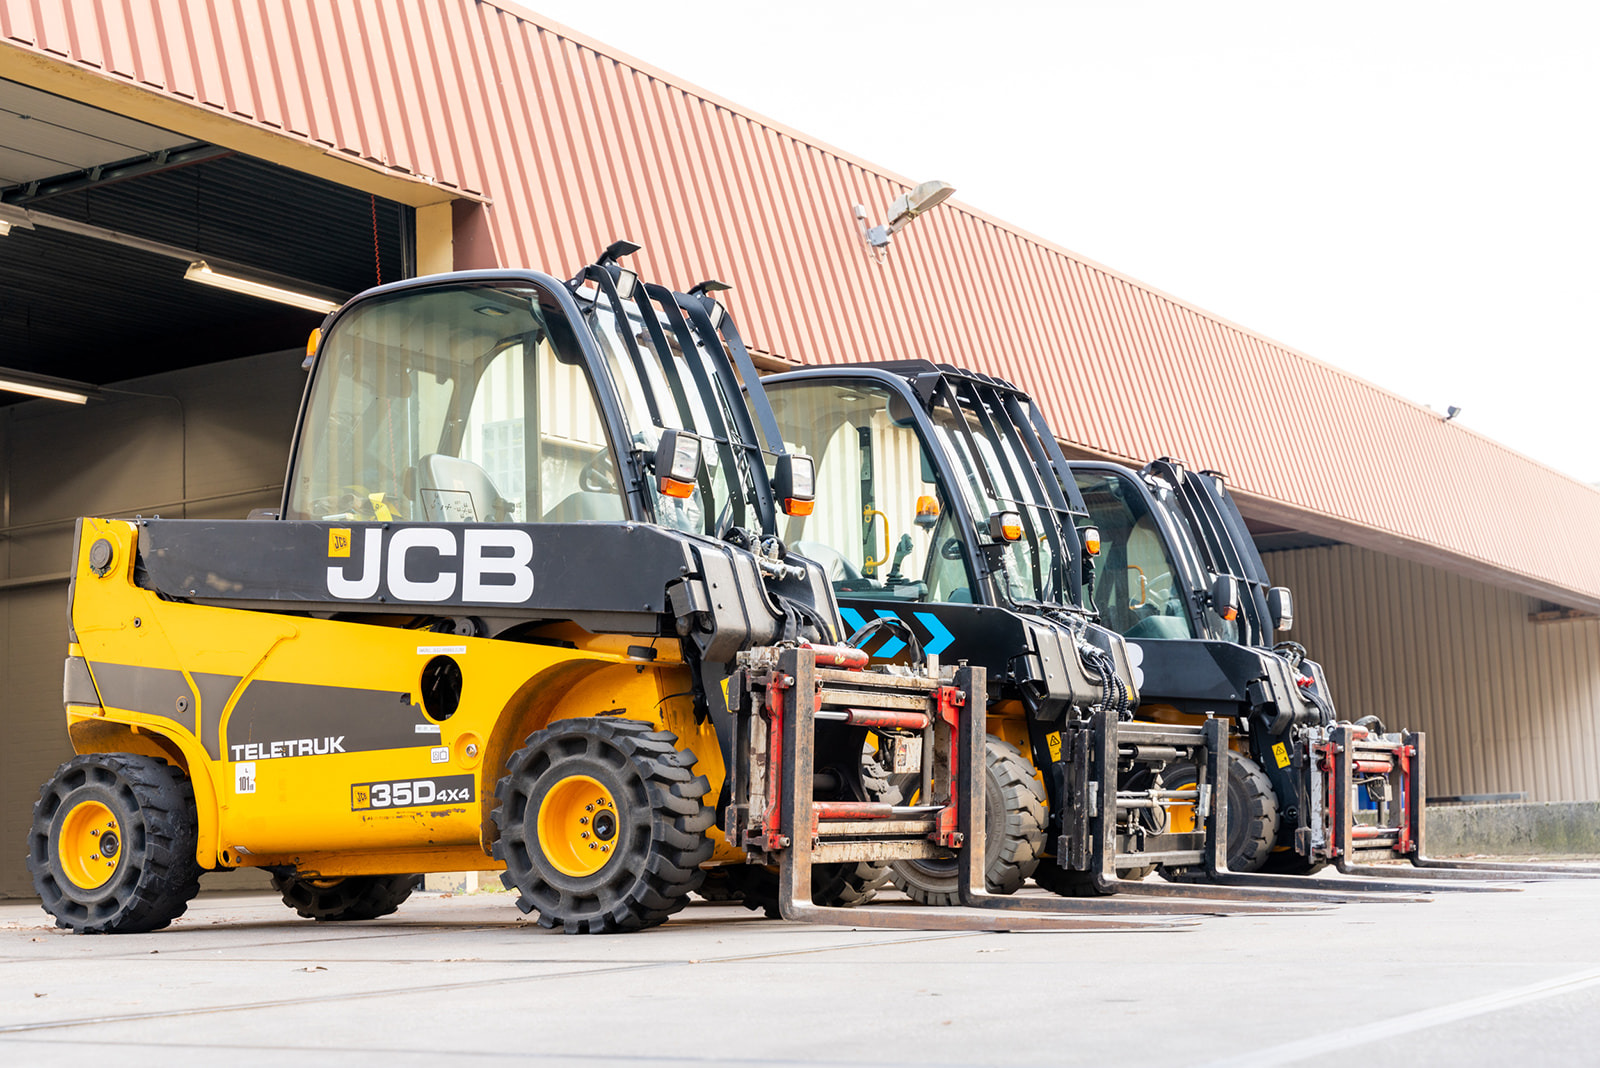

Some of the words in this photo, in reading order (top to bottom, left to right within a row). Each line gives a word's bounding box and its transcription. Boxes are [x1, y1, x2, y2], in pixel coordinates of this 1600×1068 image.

[327, 528, 534, 603] JCB
[231, 735, 346, 761] TELETRUK
[239, 776, 250, 791] 101
[371, 780, 436, 807] 35D
